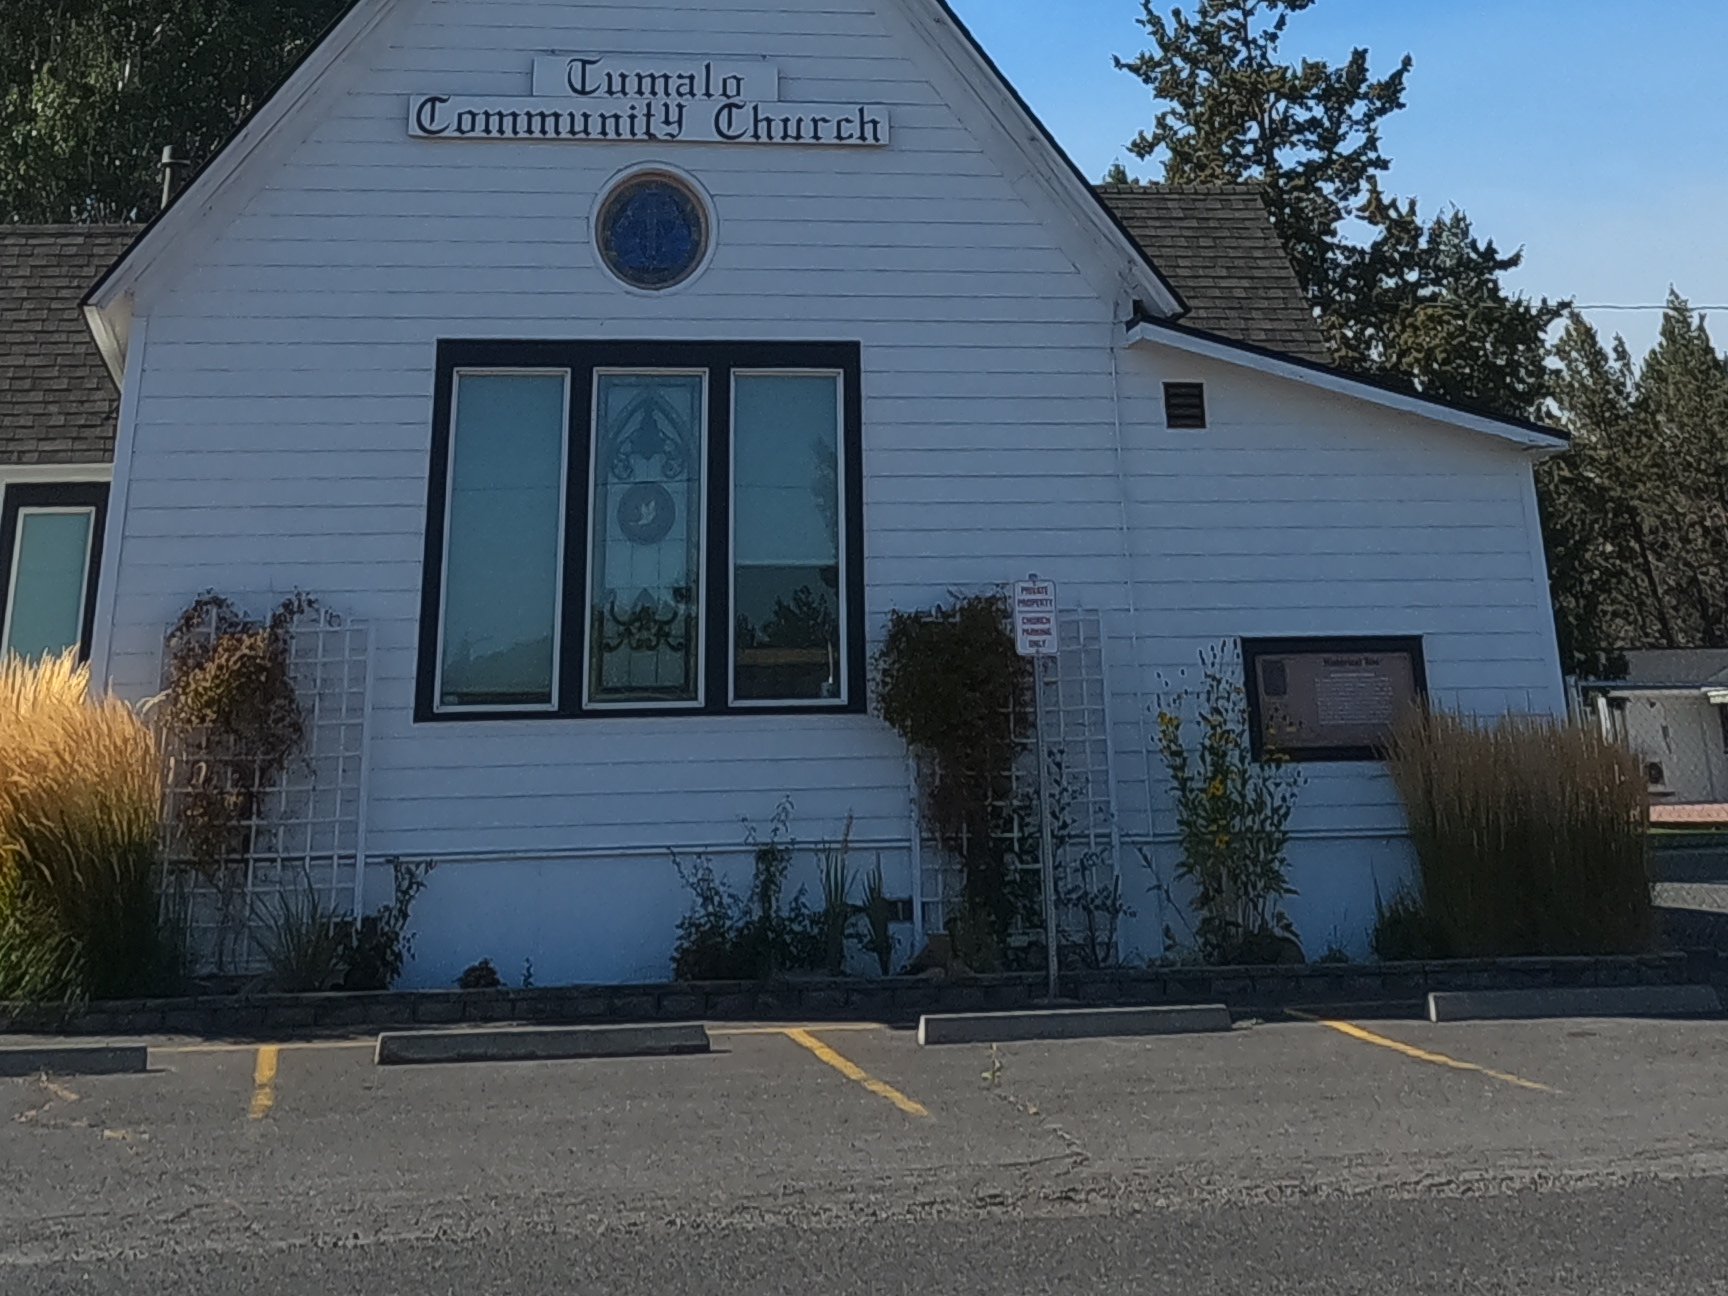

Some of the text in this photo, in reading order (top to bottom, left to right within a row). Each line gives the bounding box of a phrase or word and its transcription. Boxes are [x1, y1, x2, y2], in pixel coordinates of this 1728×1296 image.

[567, 56, 745, 99] Tumalo
[416, 95, 881, 143] Community Church
